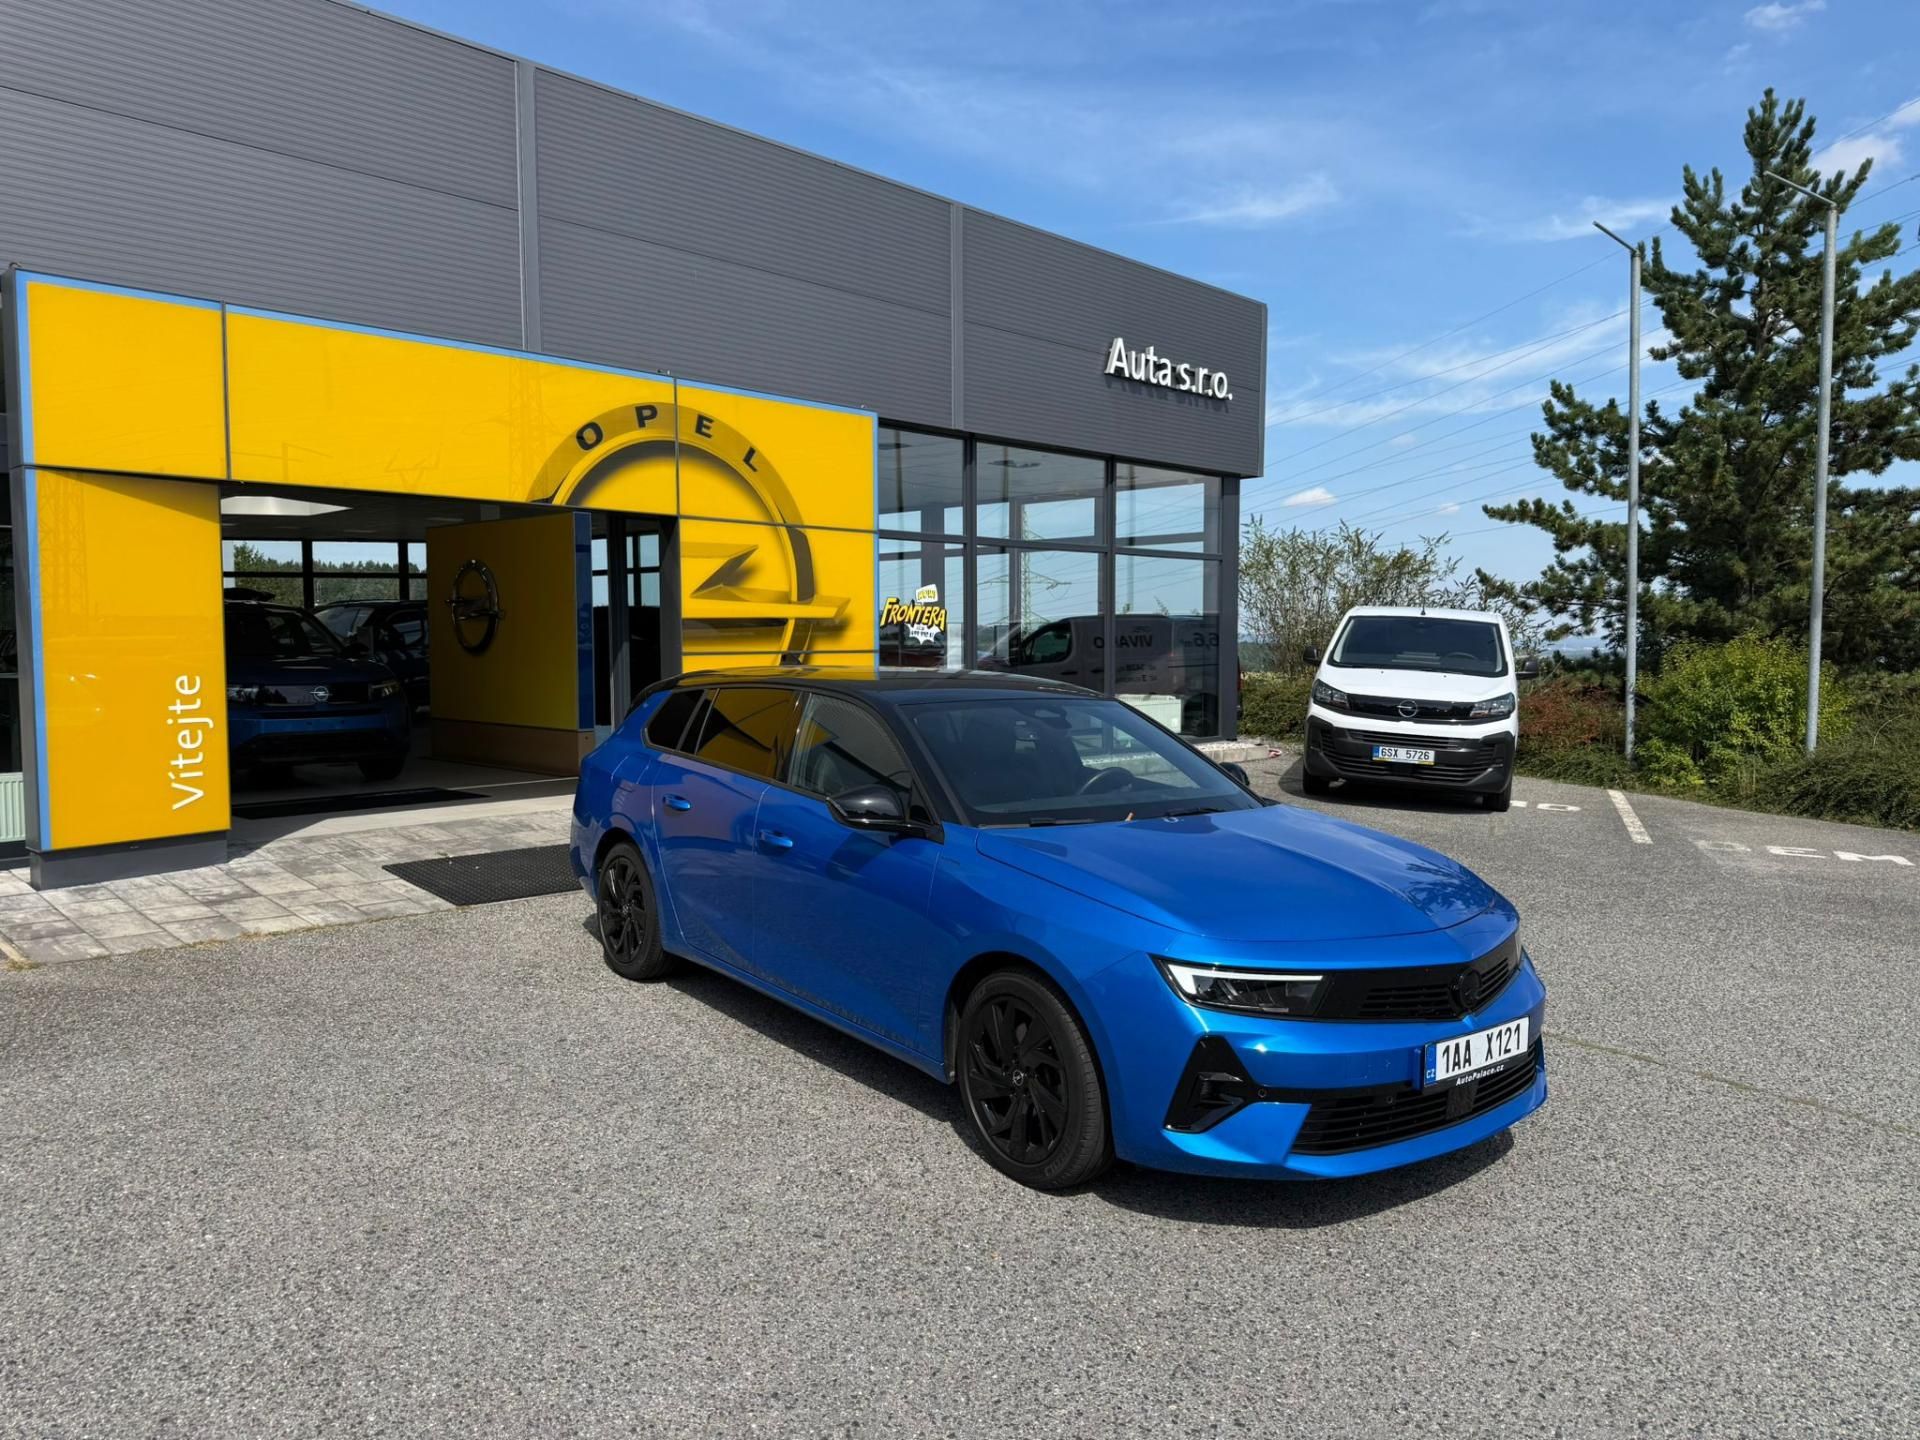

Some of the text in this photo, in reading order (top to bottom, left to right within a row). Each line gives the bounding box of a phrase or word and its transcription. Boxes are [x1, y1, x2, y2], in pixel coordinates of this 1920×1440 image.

[1104, 337, 1233, 400] Auta s.r.o.
[576, 404, 758, 473] OPEL
[880, 597, 946, 631] FRONTERA
[166, 675, 214, 810] Vítejte
[1381, 747, 1399, 758] 6SX
[1405, 749, 1430, 760] 5726
[1442, 1023, 1521, 1074] 1AA X121
[1426, 1068, 1435, 1079] CZ
[1456, 1064, 1504, 1086] AutoPalace.cz
